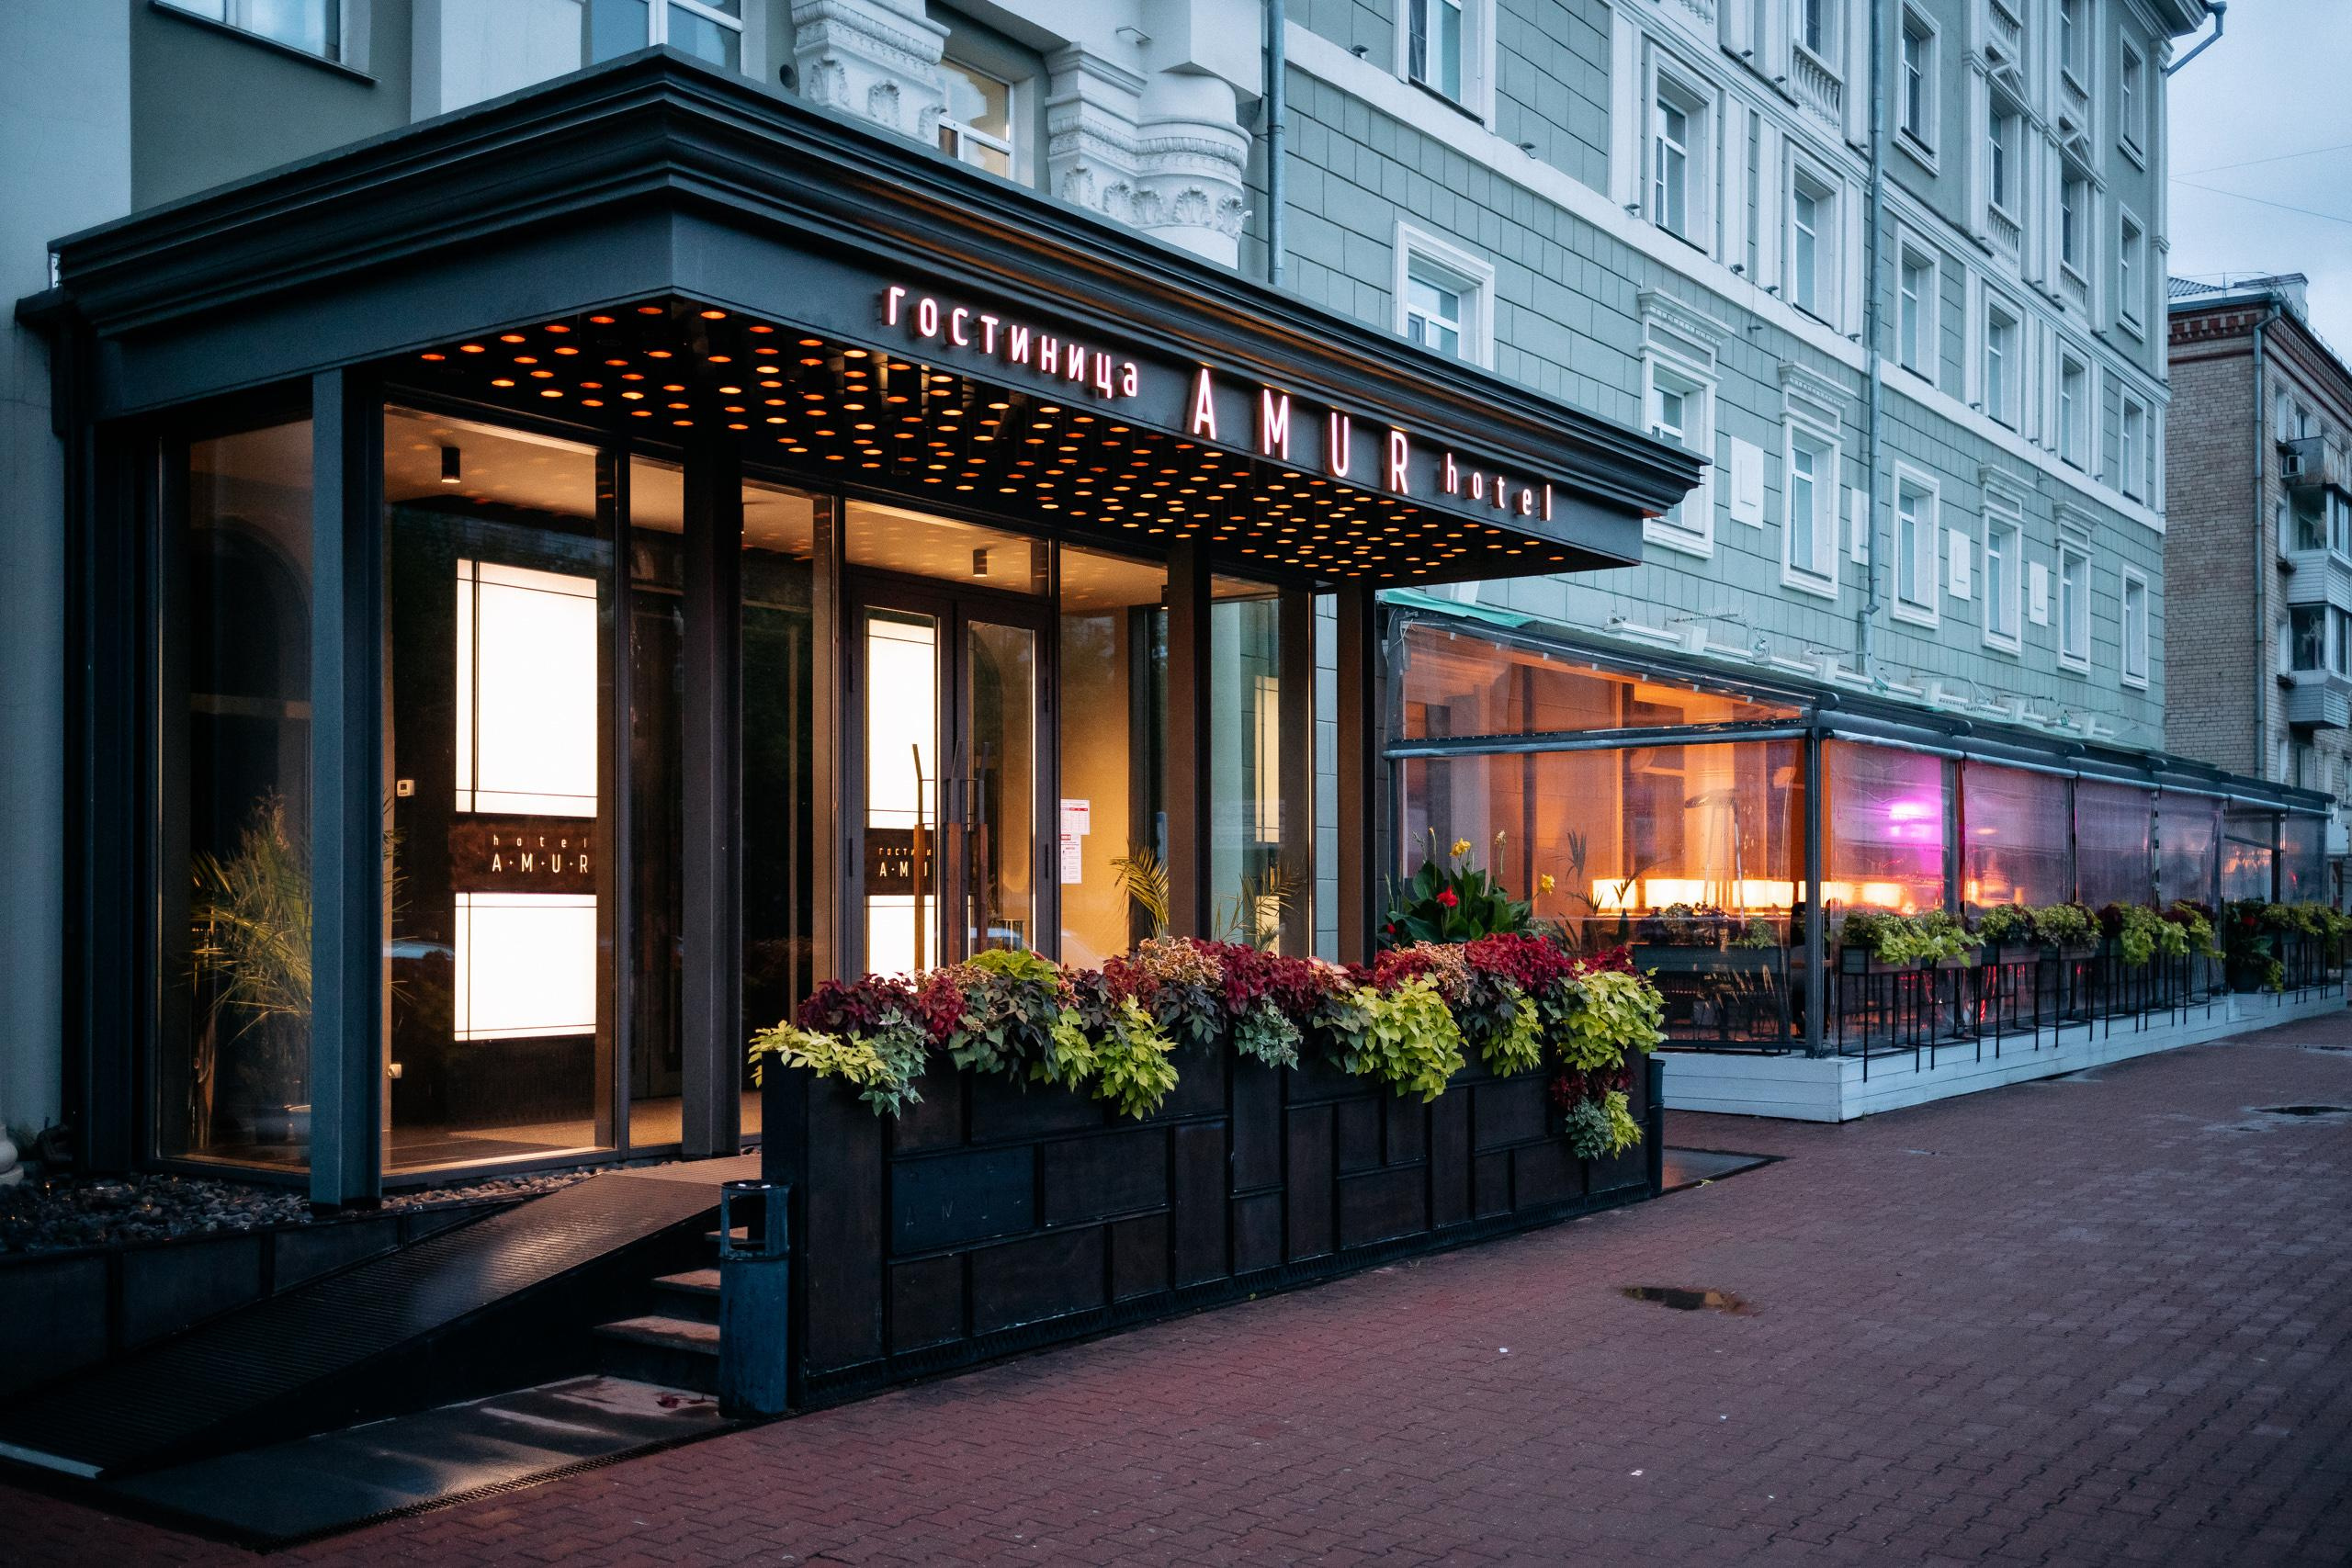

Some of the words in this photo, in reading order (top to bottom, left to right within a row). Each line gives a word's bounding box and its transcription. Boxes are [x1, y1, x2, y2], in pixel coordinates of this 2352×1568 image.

[887, 286, 1138, 399] гостиница
[1193, 367, 1409, 495] AMUR
[1446, 451, 1552, 522] hotel
[492, 834, 587, 848] hotel
